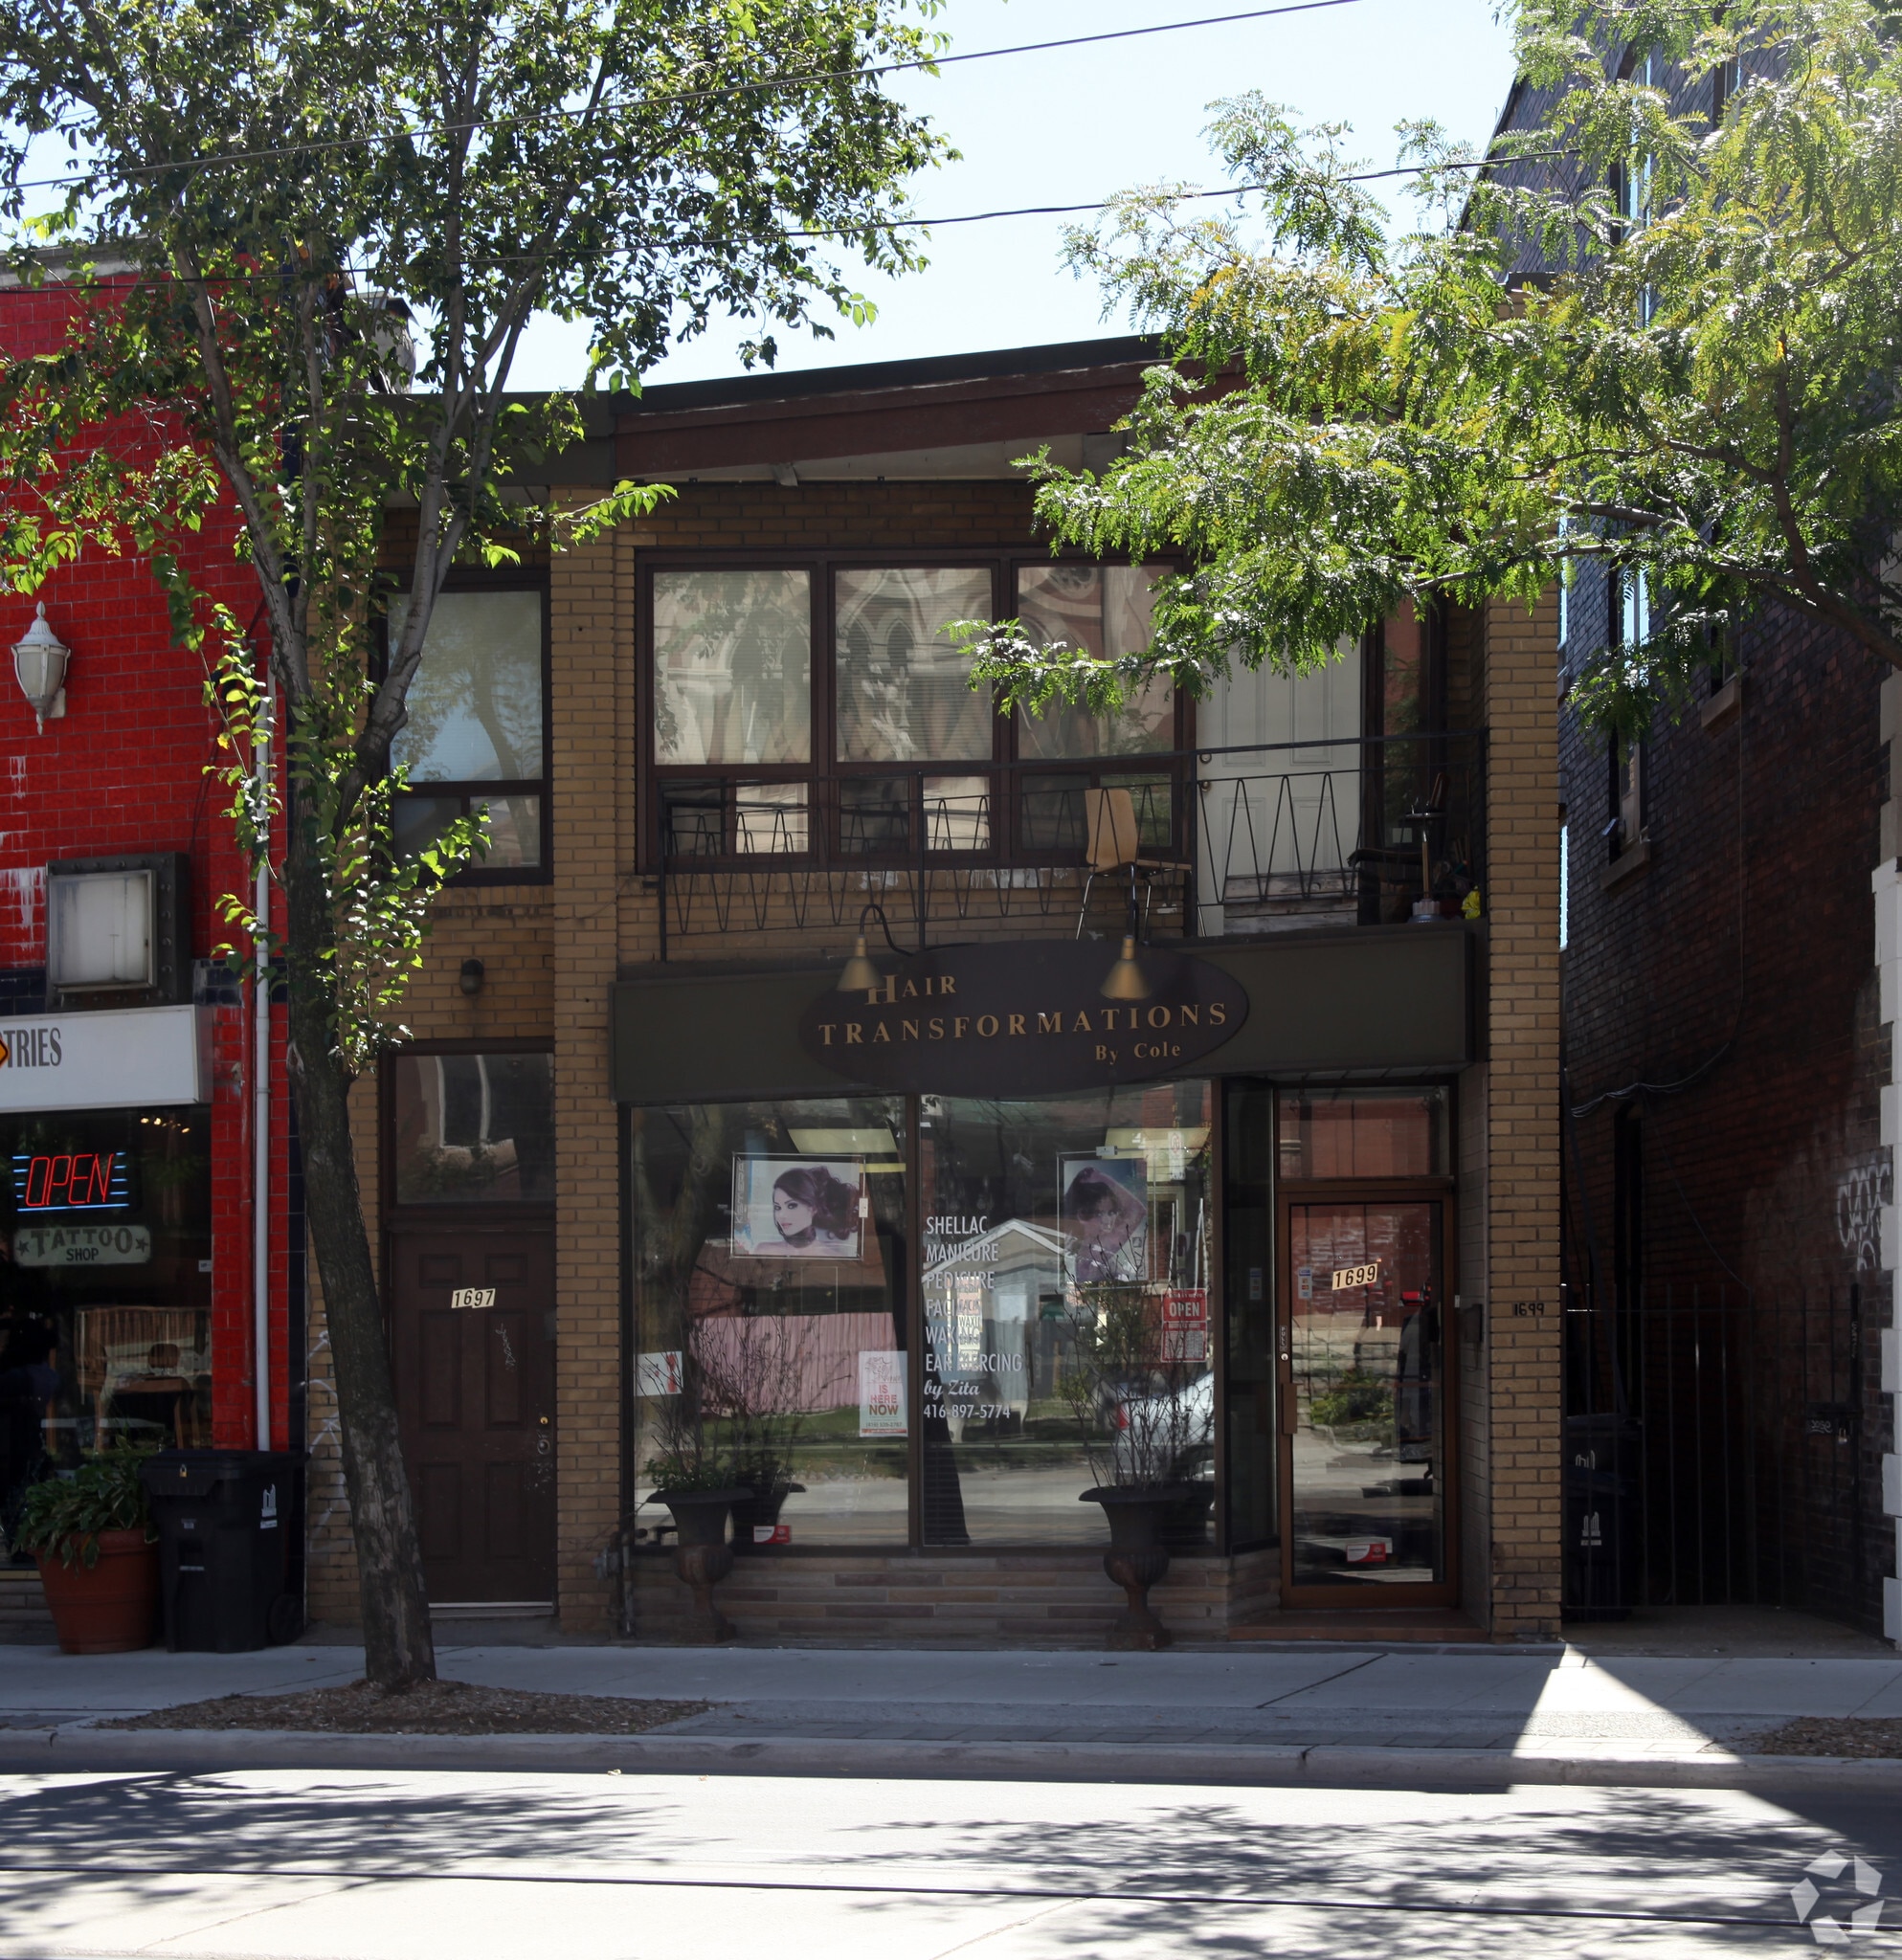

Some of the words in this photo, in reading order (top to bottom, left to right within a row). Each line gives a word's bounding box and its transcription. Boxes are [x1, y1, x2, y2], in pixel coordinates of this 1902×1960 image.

[818, 1002, 1227, 1046] TRANSFORMATIONS
[0, 1027, 63, 1069] TRIES
[1095, 1044, 1119, 1065] By
[1133, 1042, 1182, 1059] Cole
[25, 1152, 115, 1207] OPEN
[926, 1215, 988, 1235] SHELLAC
[30, 1227, 133, 1258] TATTOO
[66, 1247, 100, 1261] SHOP
[926, 1243, 999, 1262] MANICURE
[1335, 1265, 1376, 1288] 1699
[455, 1289, 494, 1307] 1697
[1169, 1302, 1200, 1318] OPEN
[1514, 1303, 1544, 1316] 1699
[926, 1353, 953, 1372] EAR
[879, 1384, 888, 1394] IS
[924, 1379, 944, 1400] by
[948, 1379, 981, 1396] Zita
[870, 1394, 898, 1404] HERE
[869, 1404, 899, 1415] NOW
[923, 1404, 1011, 1419] 416-897-5774
